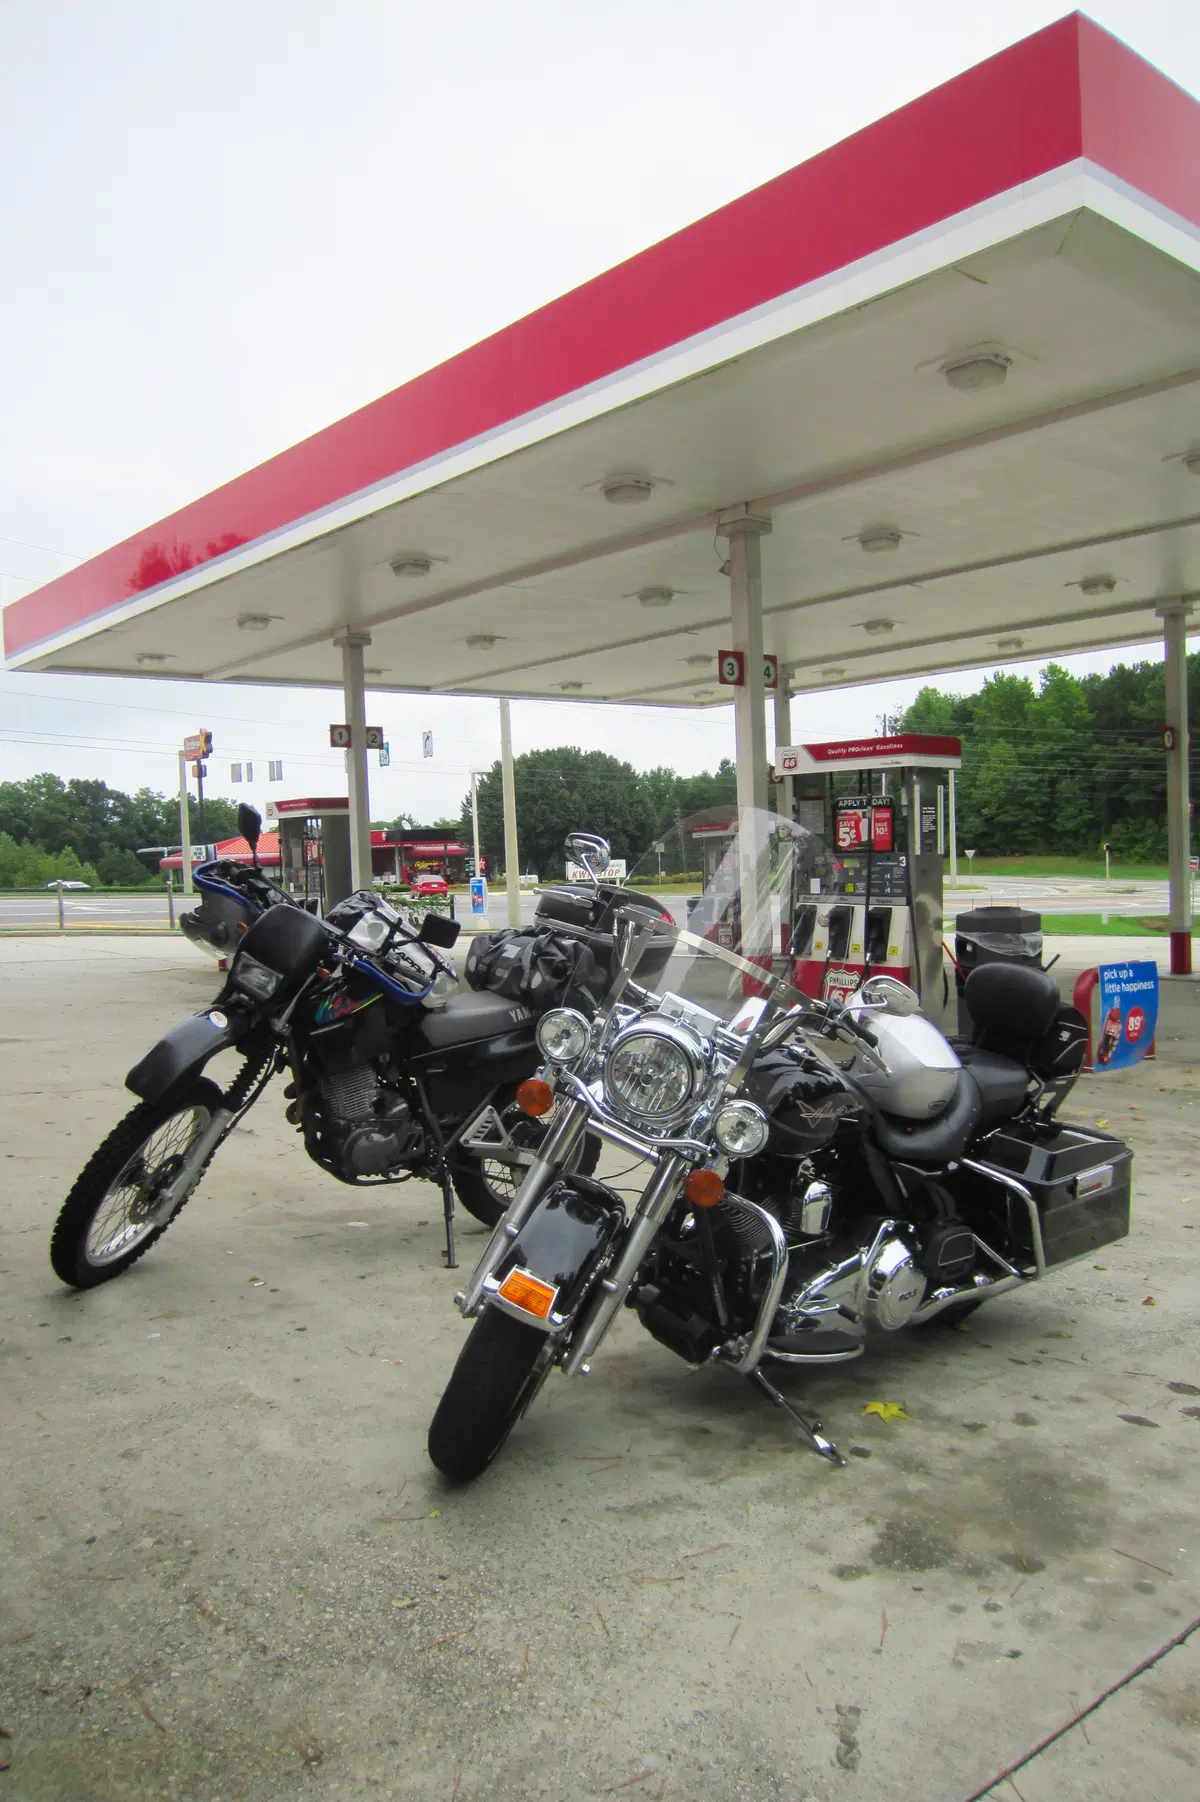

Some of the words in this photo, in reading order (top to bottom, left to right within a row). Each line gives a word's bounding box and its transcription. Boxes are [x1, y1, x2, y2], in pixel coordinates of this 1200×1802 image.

[727, 662, 735, 676] 3
[764, 666, 771, 678] 4
[337, 731, 343, 741] 1
[370, 733, 378, 743] 2
[875, 743, 903, 751] Gasolines
[784, 759, 795, 767] 66
[862, 798, 890, 806] TDAY!
[899, 856, 906, 867] 3
[392, 948, 426, 975] APPA
[1104, 968, 1118, 981] pick
[1119, 970, 1128, 980] up
[1129, 969, 1133, 977] a
[829, 976, 858, 986] PHILLIPS
[1105, 981, 1120, 993] little
[1122, 980, 1154, 993] happiness
